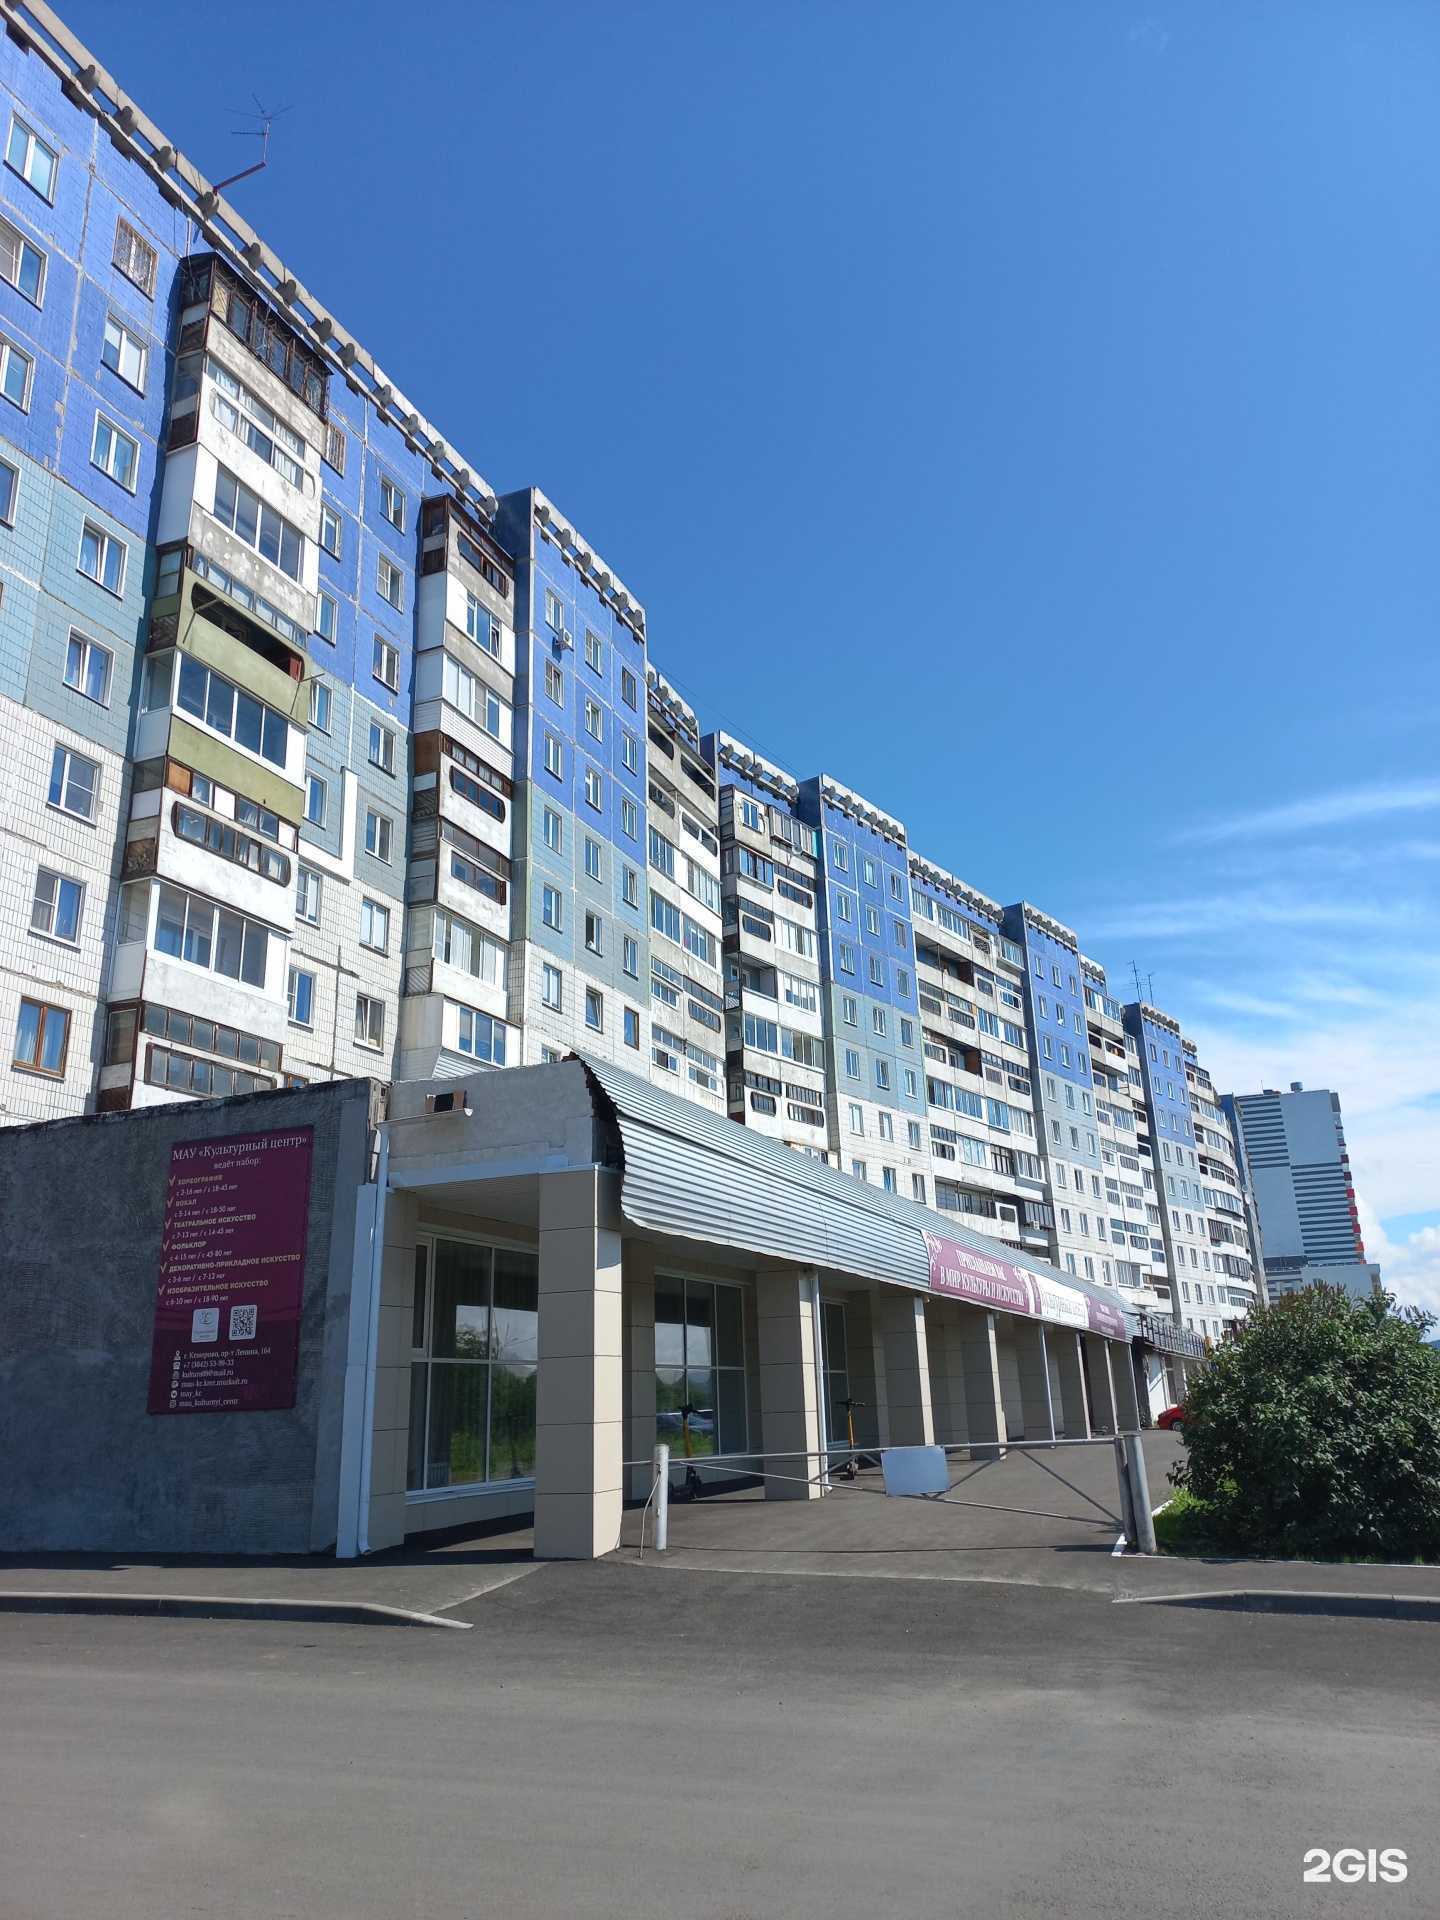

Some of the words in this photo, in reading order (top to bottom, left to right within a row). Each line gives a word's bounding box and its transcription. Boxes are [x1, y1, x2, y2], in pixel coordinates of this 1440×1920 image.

[172, 1147, 198, 1161] МАУ
[198, 1138, 268, 1159] «Культурный
[270, 1135, 307, 1149] центр»
[174, 1218, 217, 1229] ТЕАТРАЛЬНОЕ
[218, 1213, 256, 1224] ИСКУССТВО
[171, 1240, 207, 1250] ФОЛЬКЛОР
[261, 1253, 301, 1264] ИСКУССТВО
[940, 1265, 946, 1285] В
[945, 1267, 962, 1289] МИР
[230, 1279, 269, 1290] ИСКУССТВО
